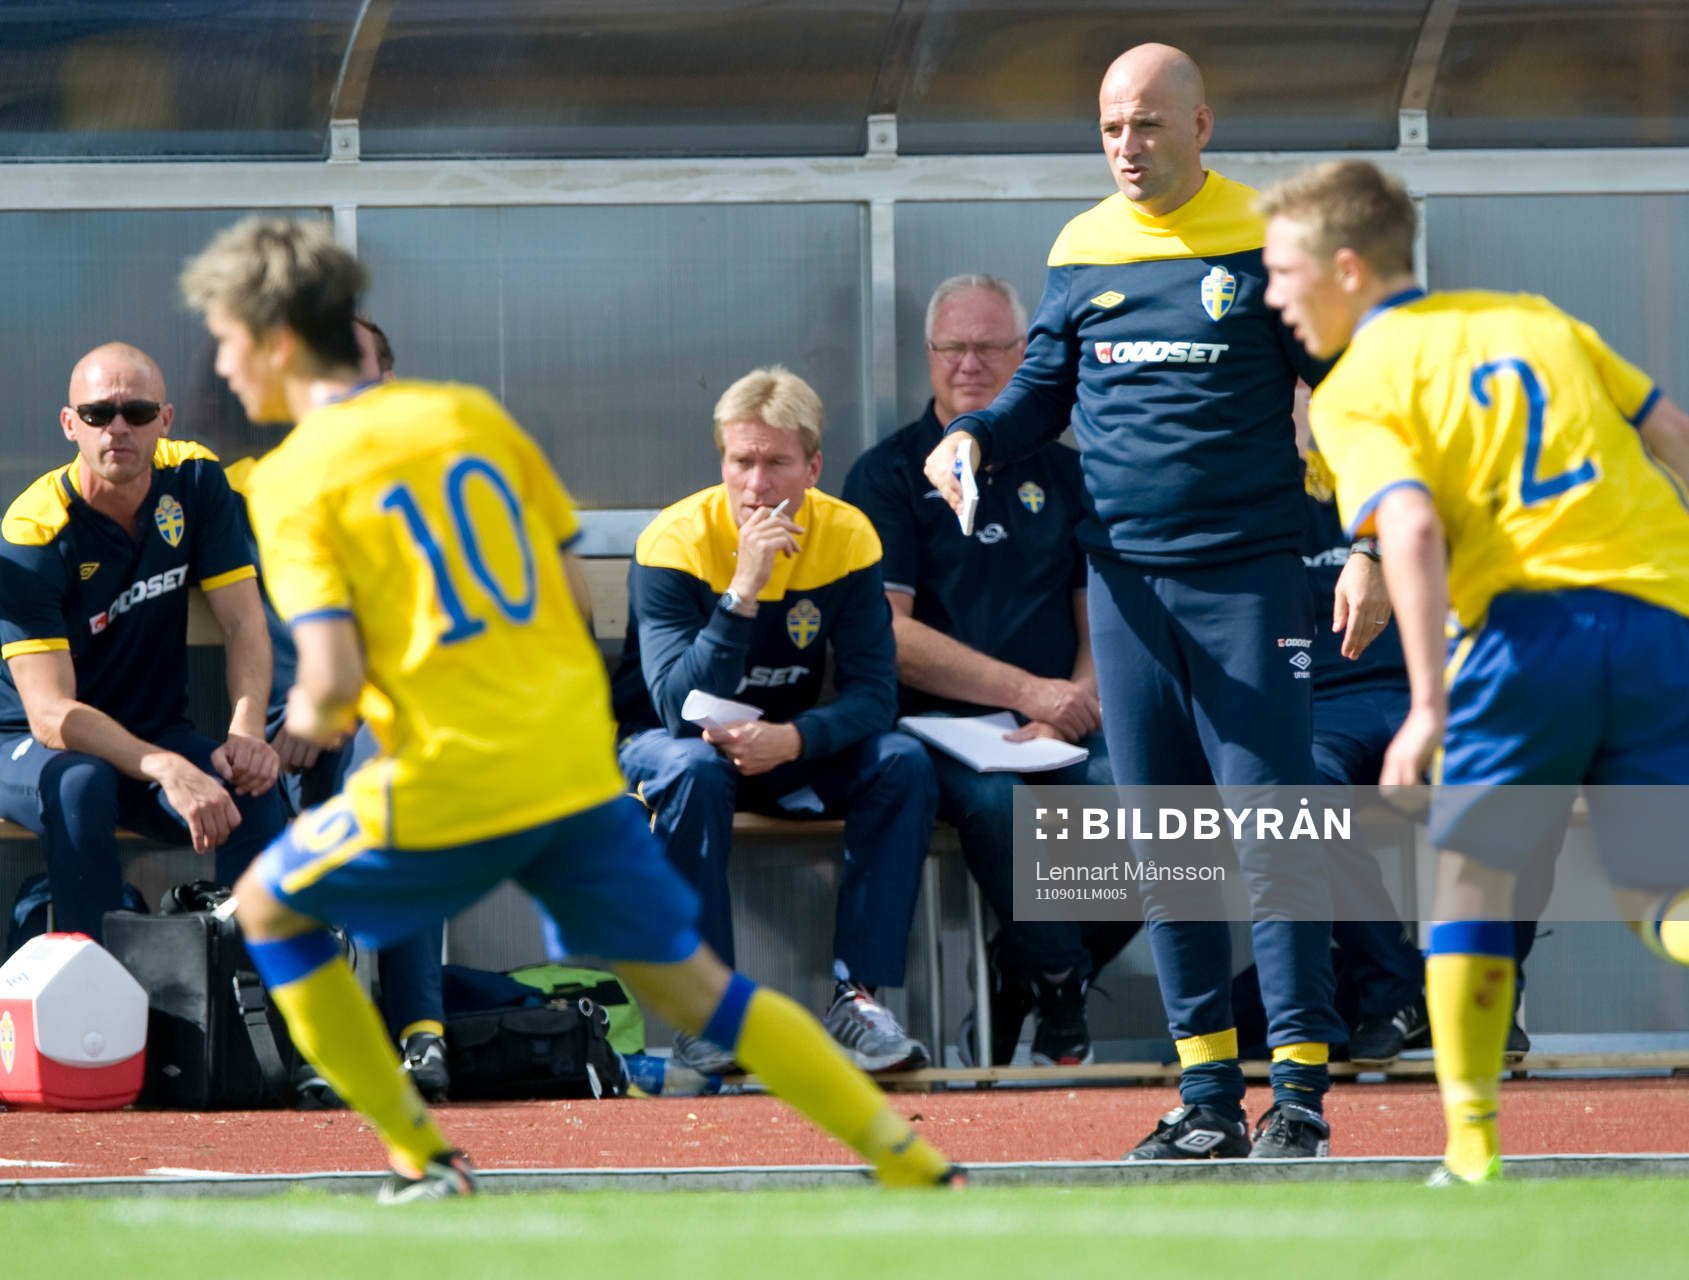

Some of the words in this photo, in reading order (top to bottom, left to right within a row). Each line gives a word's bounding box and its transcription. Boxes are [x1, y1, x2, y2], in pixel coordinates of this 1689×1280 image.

[1112, 341, 1229, 364] ODDSET
[1470, 357, 1597, 507] 2
[382, 458, 537, 645] 10
